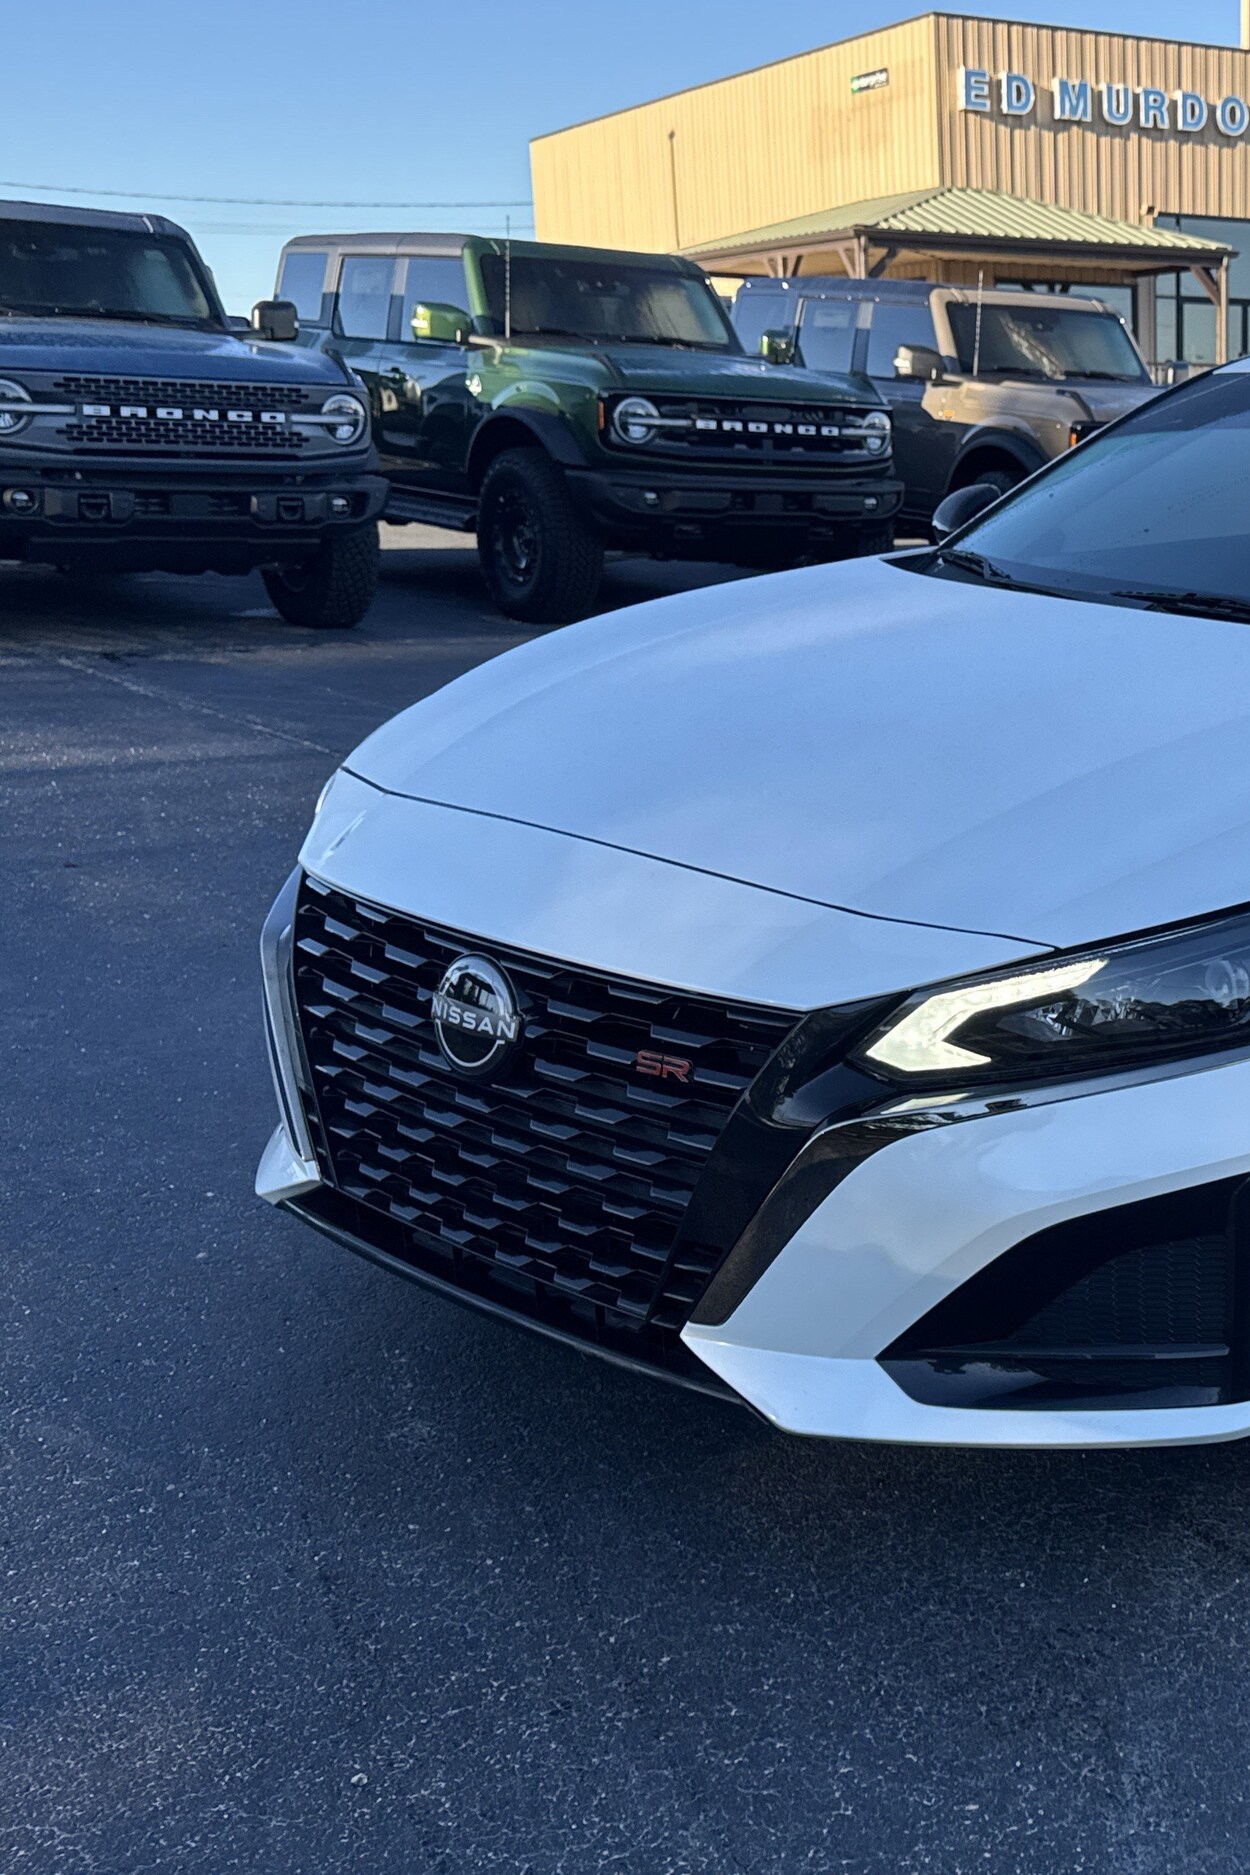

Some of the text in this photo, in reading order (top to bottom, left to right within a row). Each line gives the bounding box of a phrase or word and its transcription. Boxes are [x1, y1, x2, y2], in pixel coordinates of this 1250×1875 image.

[957, 66, 1035, 115] ED
[82, 404, 286, 423] BRONCO
[696, 419, 840, 437] BRONCO
[432, 998, 516, 1039] NISSAN
[636, 1050, 690, 1083] SR
